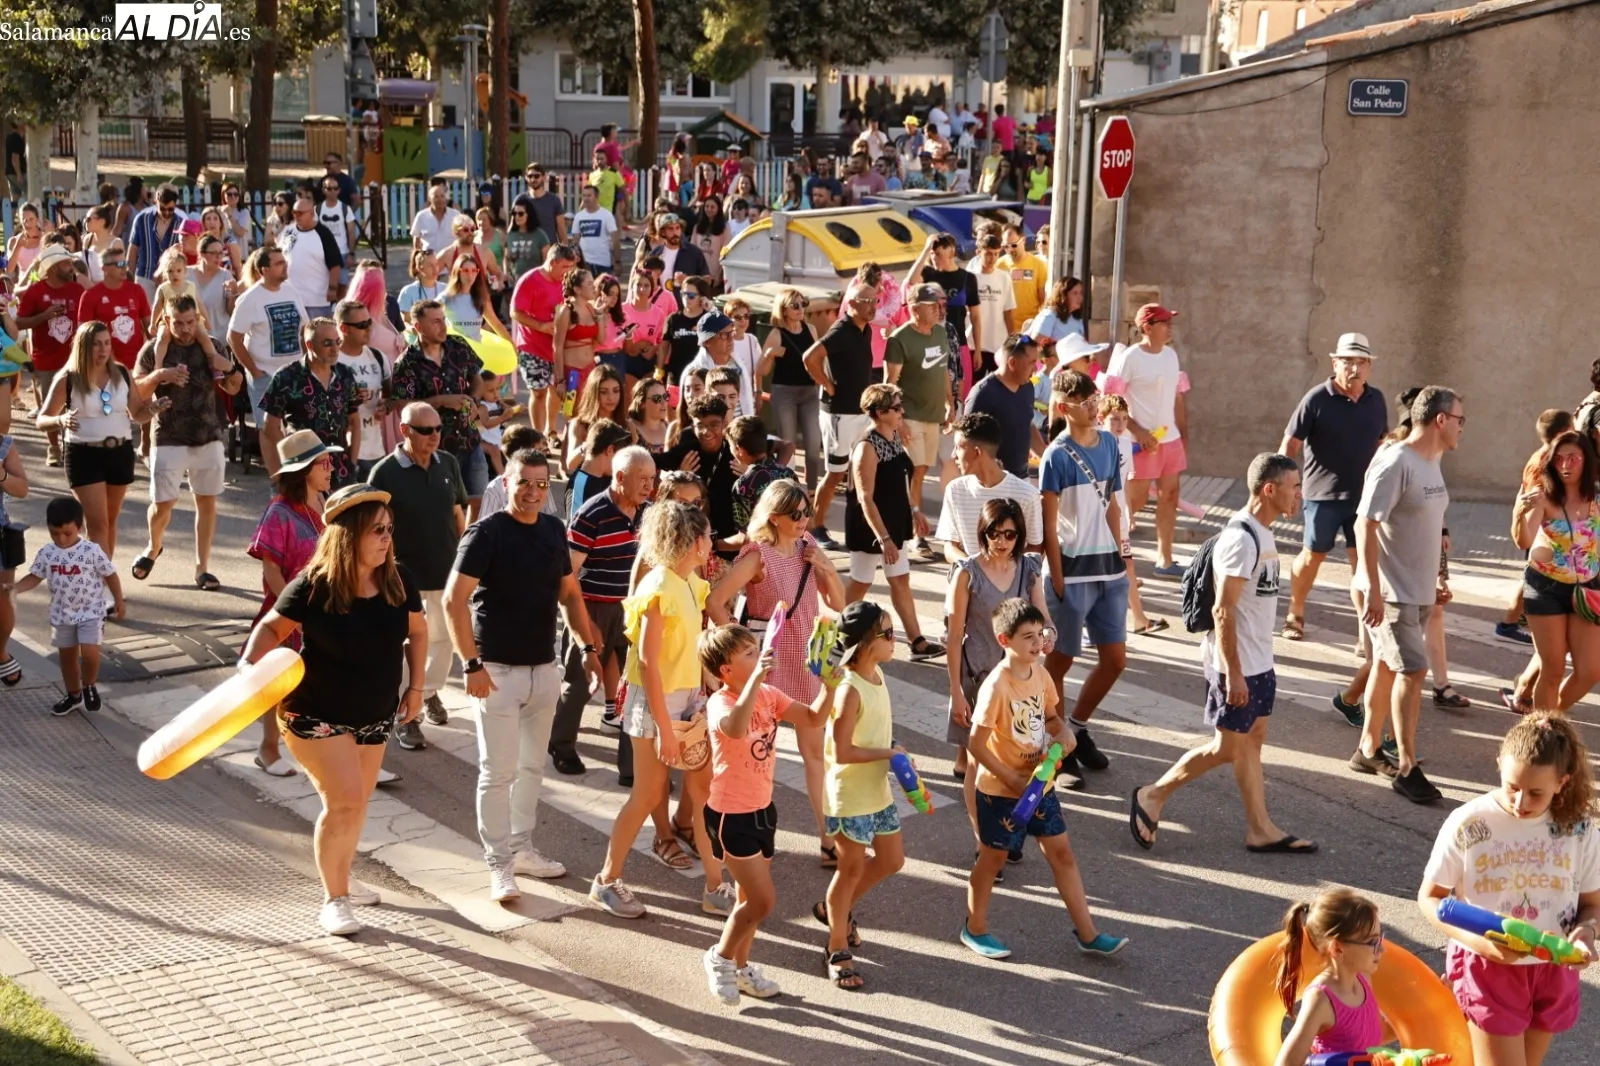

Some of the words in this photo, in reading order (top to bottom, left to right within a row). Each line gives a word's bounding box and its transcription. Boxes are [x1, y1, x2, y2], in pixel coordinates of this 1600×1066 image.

[1366, 84, 1391, 96] Calle
[1352, 97, 1371, 109] San
[1374, 97, 1402, 109] Pedro
[1102, 148, 1132, 169] STOP
[647, 327, 655, 336] 8
[50, 564, 82, 576] FILA
[1552, 852, 1572, 871] at
